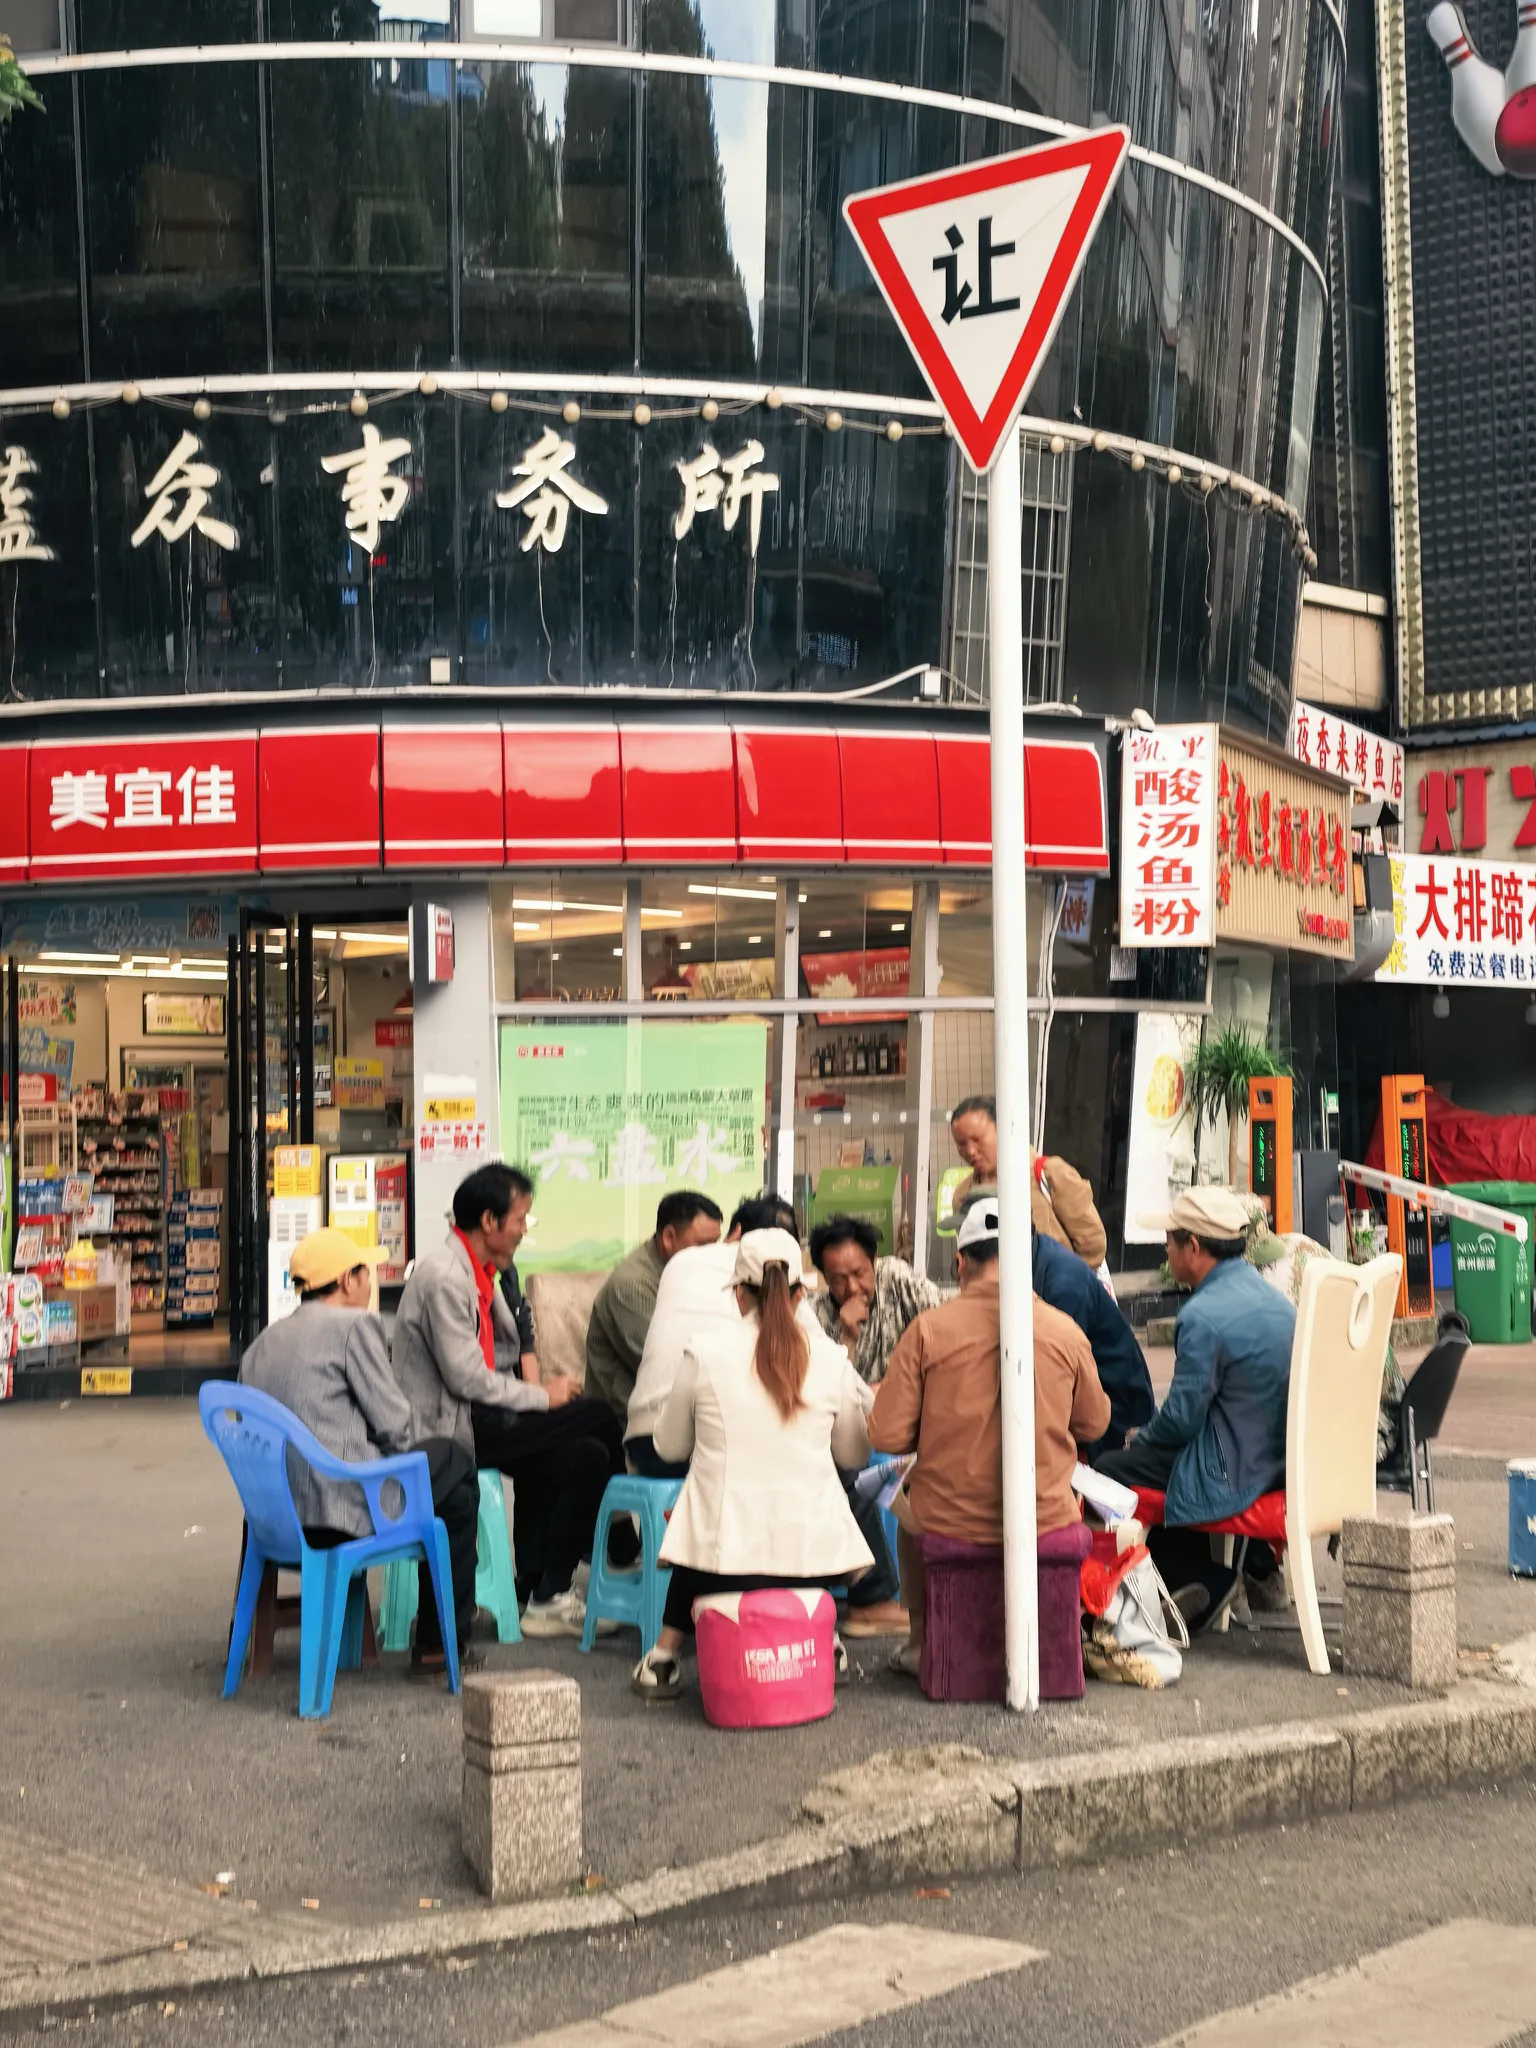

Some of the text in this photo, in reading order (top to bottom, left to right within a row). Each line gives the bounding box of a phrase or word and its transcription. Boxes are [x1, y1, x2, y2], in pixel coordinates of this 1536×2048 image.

[932, 214, 1021, 326] 让
[49, 763, 237, 833] 美宜佳
[1296, 705, 1404, 800] 夜香来烤鱼店
[1132, 766, 1202, 937] 酸汤鱼粉
[1414, 864, 1536, 947] 大排蹄
